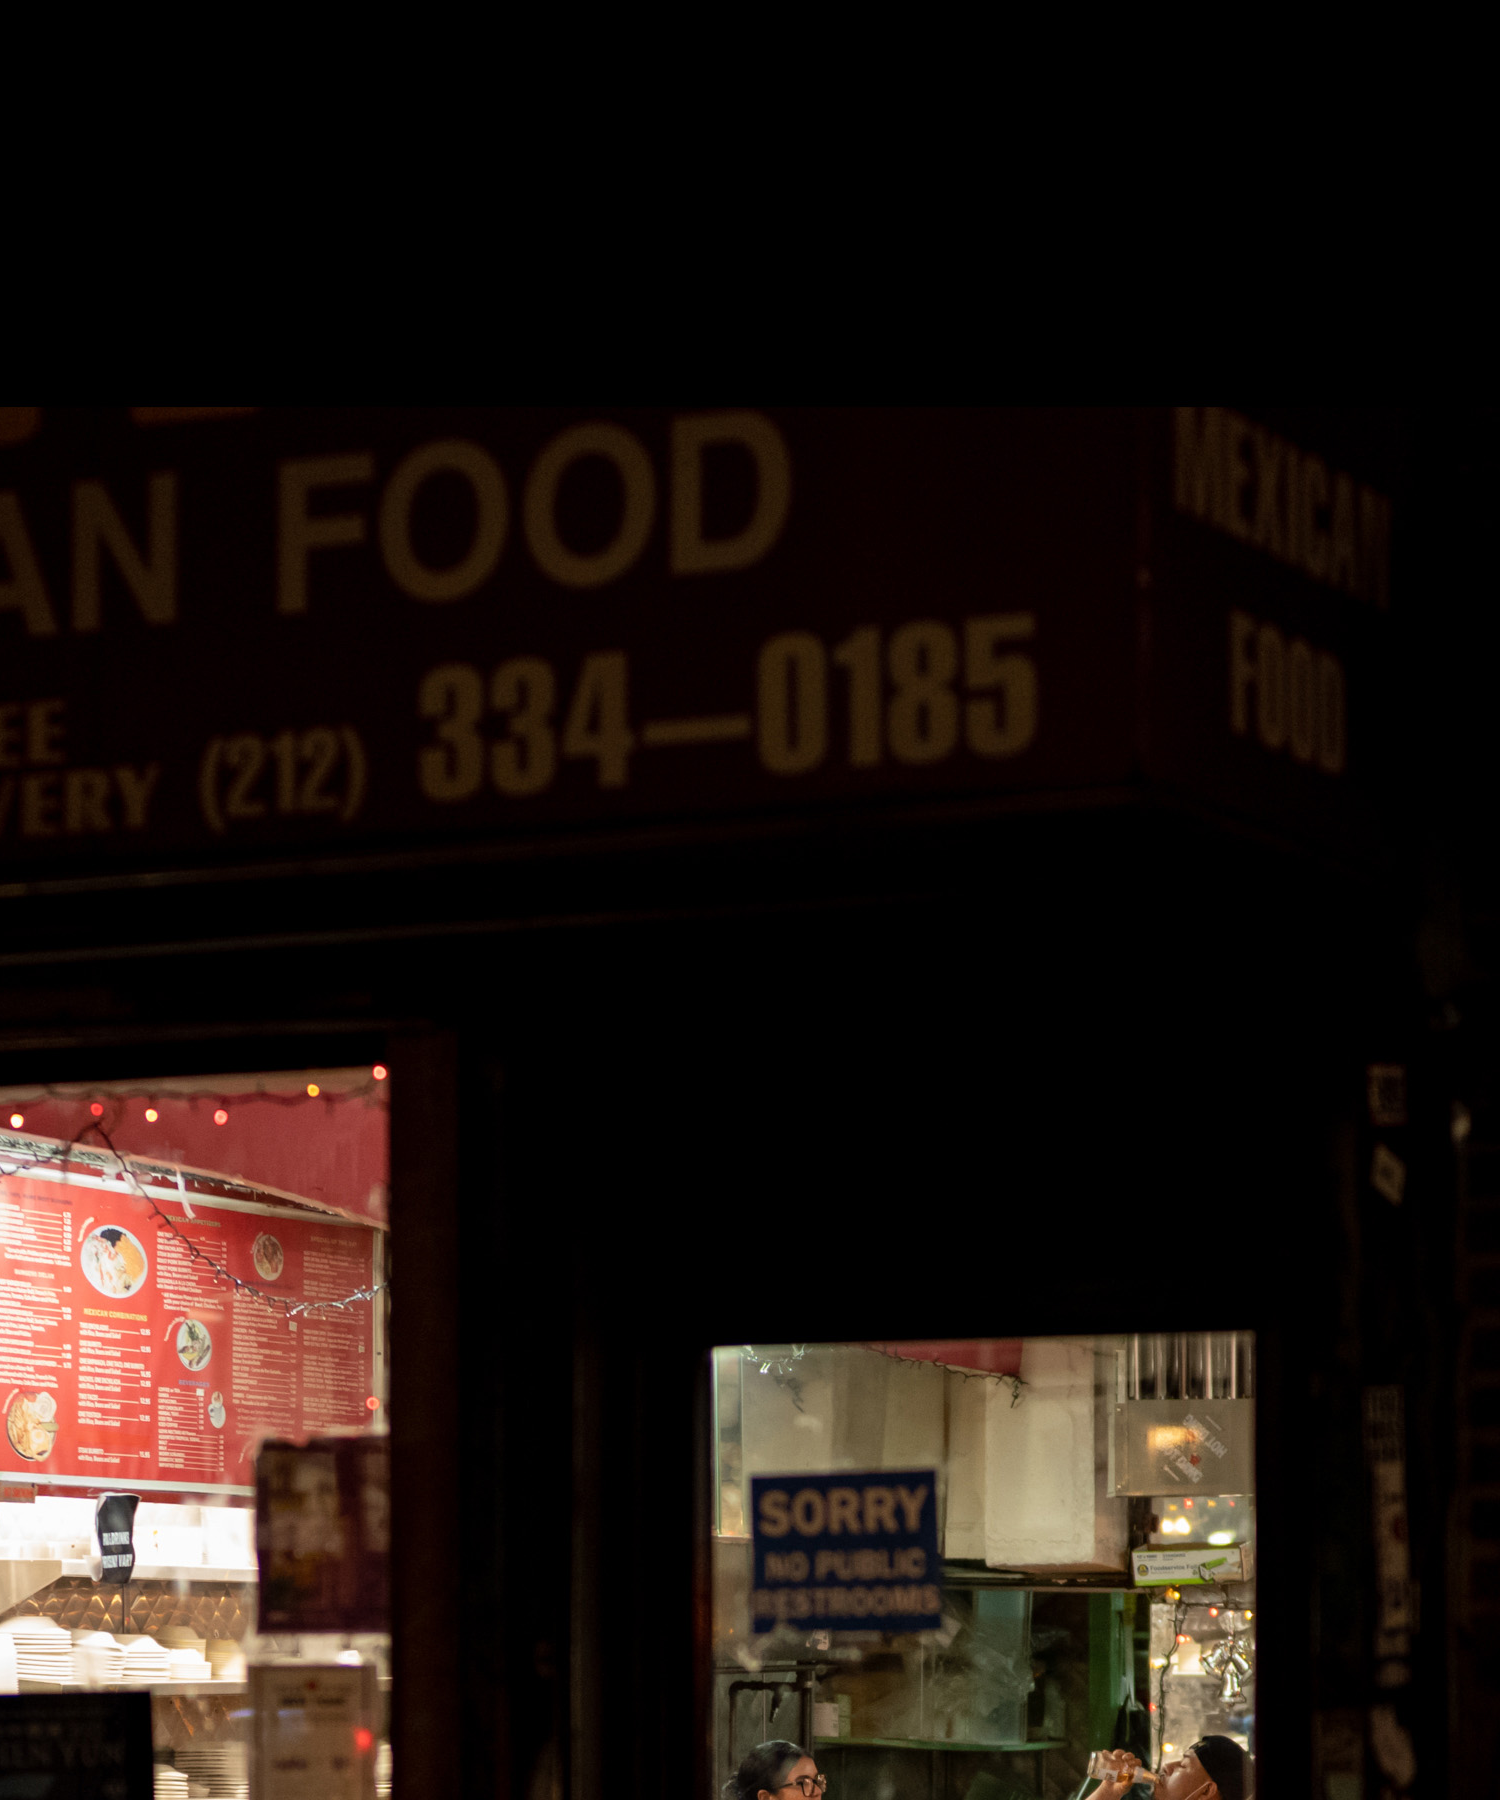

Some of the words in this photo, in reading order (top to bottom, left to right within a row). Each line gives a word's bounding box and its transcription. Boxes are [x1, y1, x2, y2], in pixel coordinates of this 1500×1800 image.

[275, 408, 795, 618] FOOD
[1172, 406, 1396, 613] MEXICAN
[1228, 607, 1349, 778] FOOD
[199, 723, 370, 837] (212)
[83, 1307, 108, 1317] MEXICAN
[757, 1485, 929, 1538] SORRY
[764, 1550, 811, 1583] NO
[814, 1546, 928, 1582] PUBLIC
